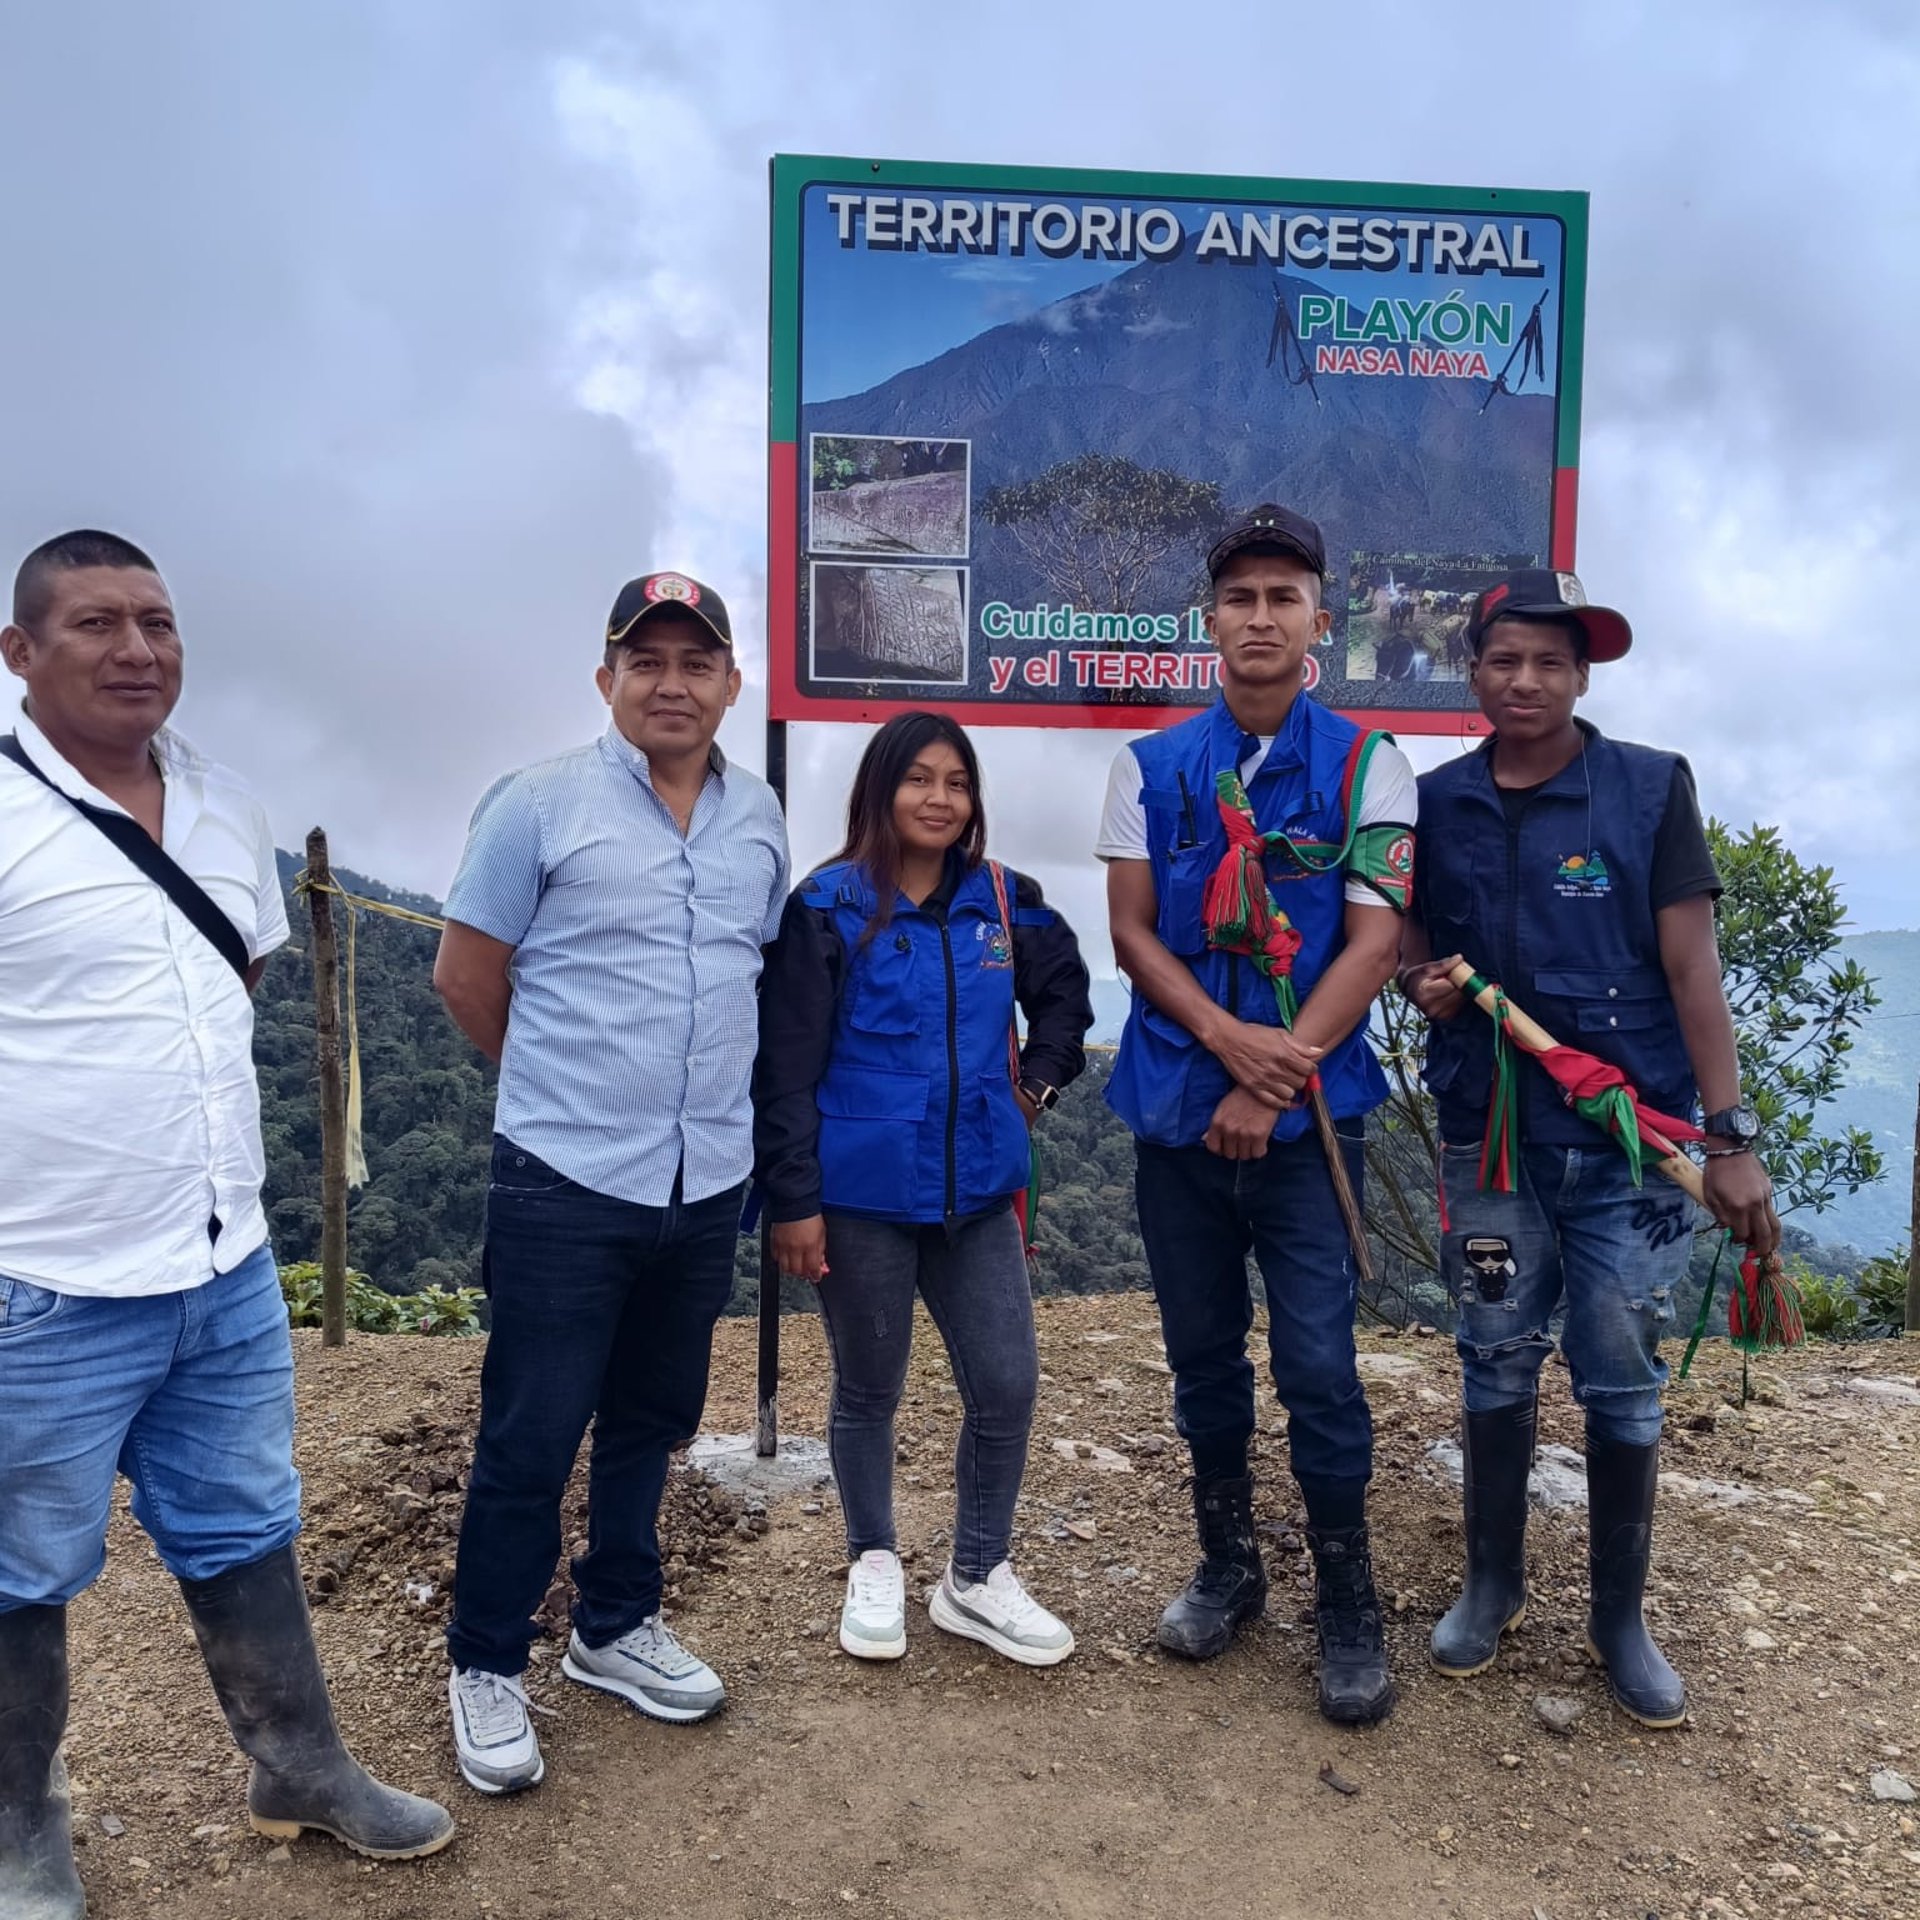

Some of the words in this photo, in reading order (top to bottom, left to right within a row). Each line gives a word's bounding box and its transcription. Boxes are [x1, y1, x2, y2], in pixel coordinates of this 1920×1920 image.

[826, 193, 1184, 260] TERRITORIO
[1196, 211, 1542, 274] ANCESTRAL
[1300, 290, 1511, 345] PLAYÓN
[1316, 346, 1401, 375] NASA
[1409, 348, 1490, 378] NAYA
[980, 601, 1178, 642] Cuidamos
[988, 655, 1016, 693] y
[1024, 651, 1061, 686] el
[1070, 651, 1320, 691] TERRIT
